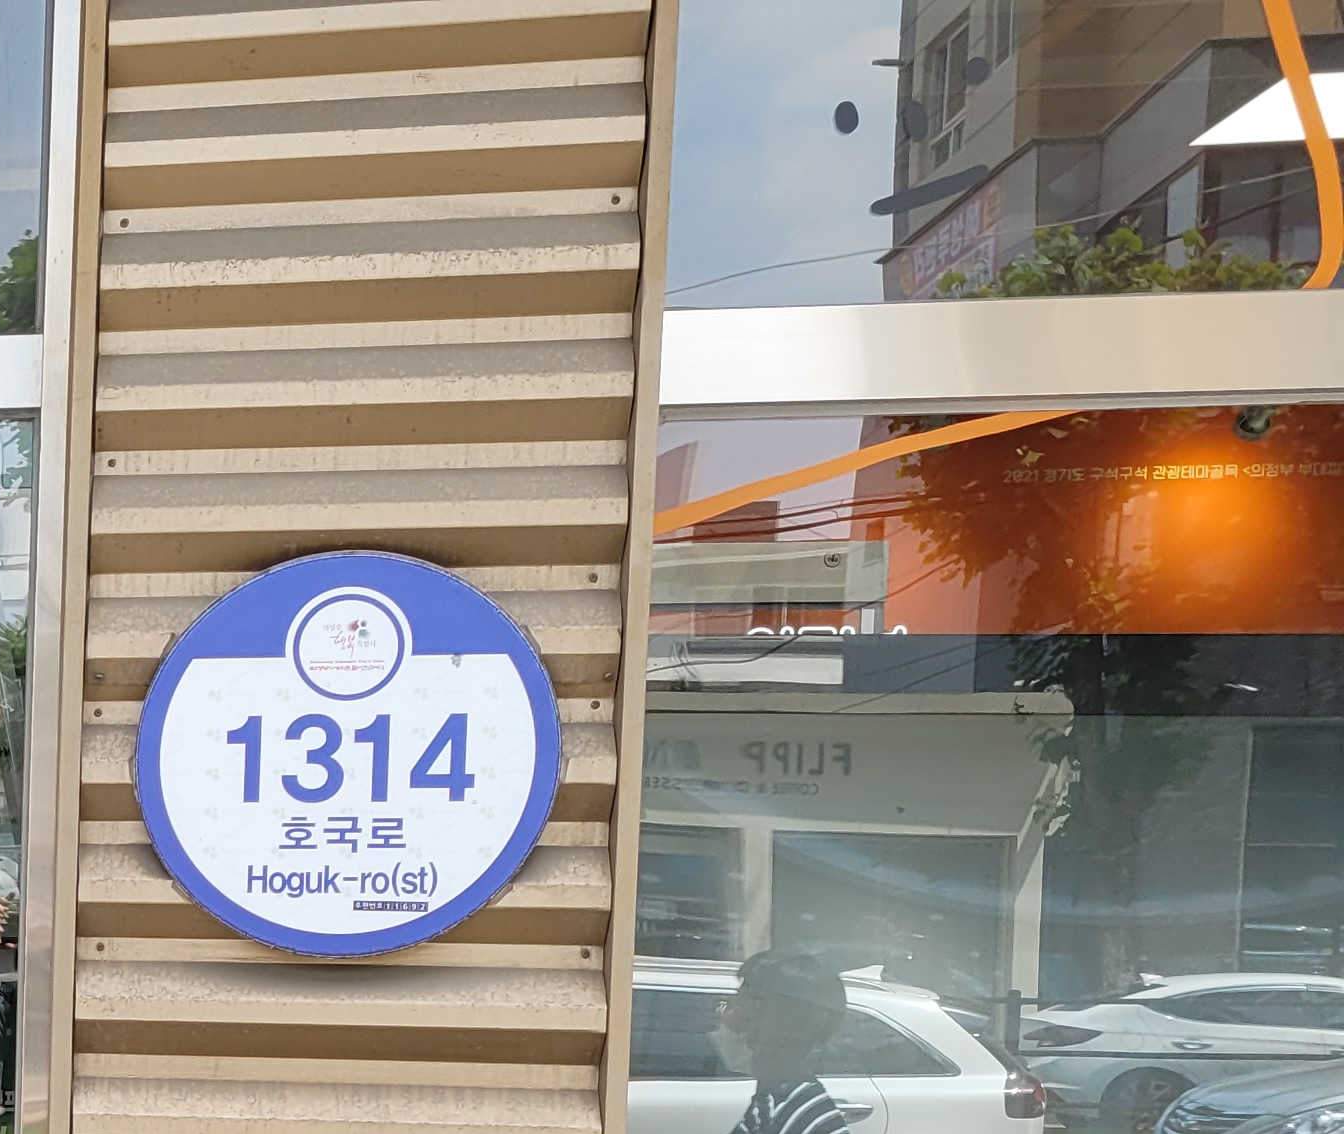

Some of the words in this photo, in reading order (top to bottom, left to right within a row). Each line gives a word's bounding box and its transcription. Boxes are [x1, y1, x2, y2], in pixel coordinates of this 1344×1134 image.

[226, 713, 476, 804] 1314
[278, 816, 408, 853] 호국로
[246, 861, 439, 898] Hoguk-ro(st)
